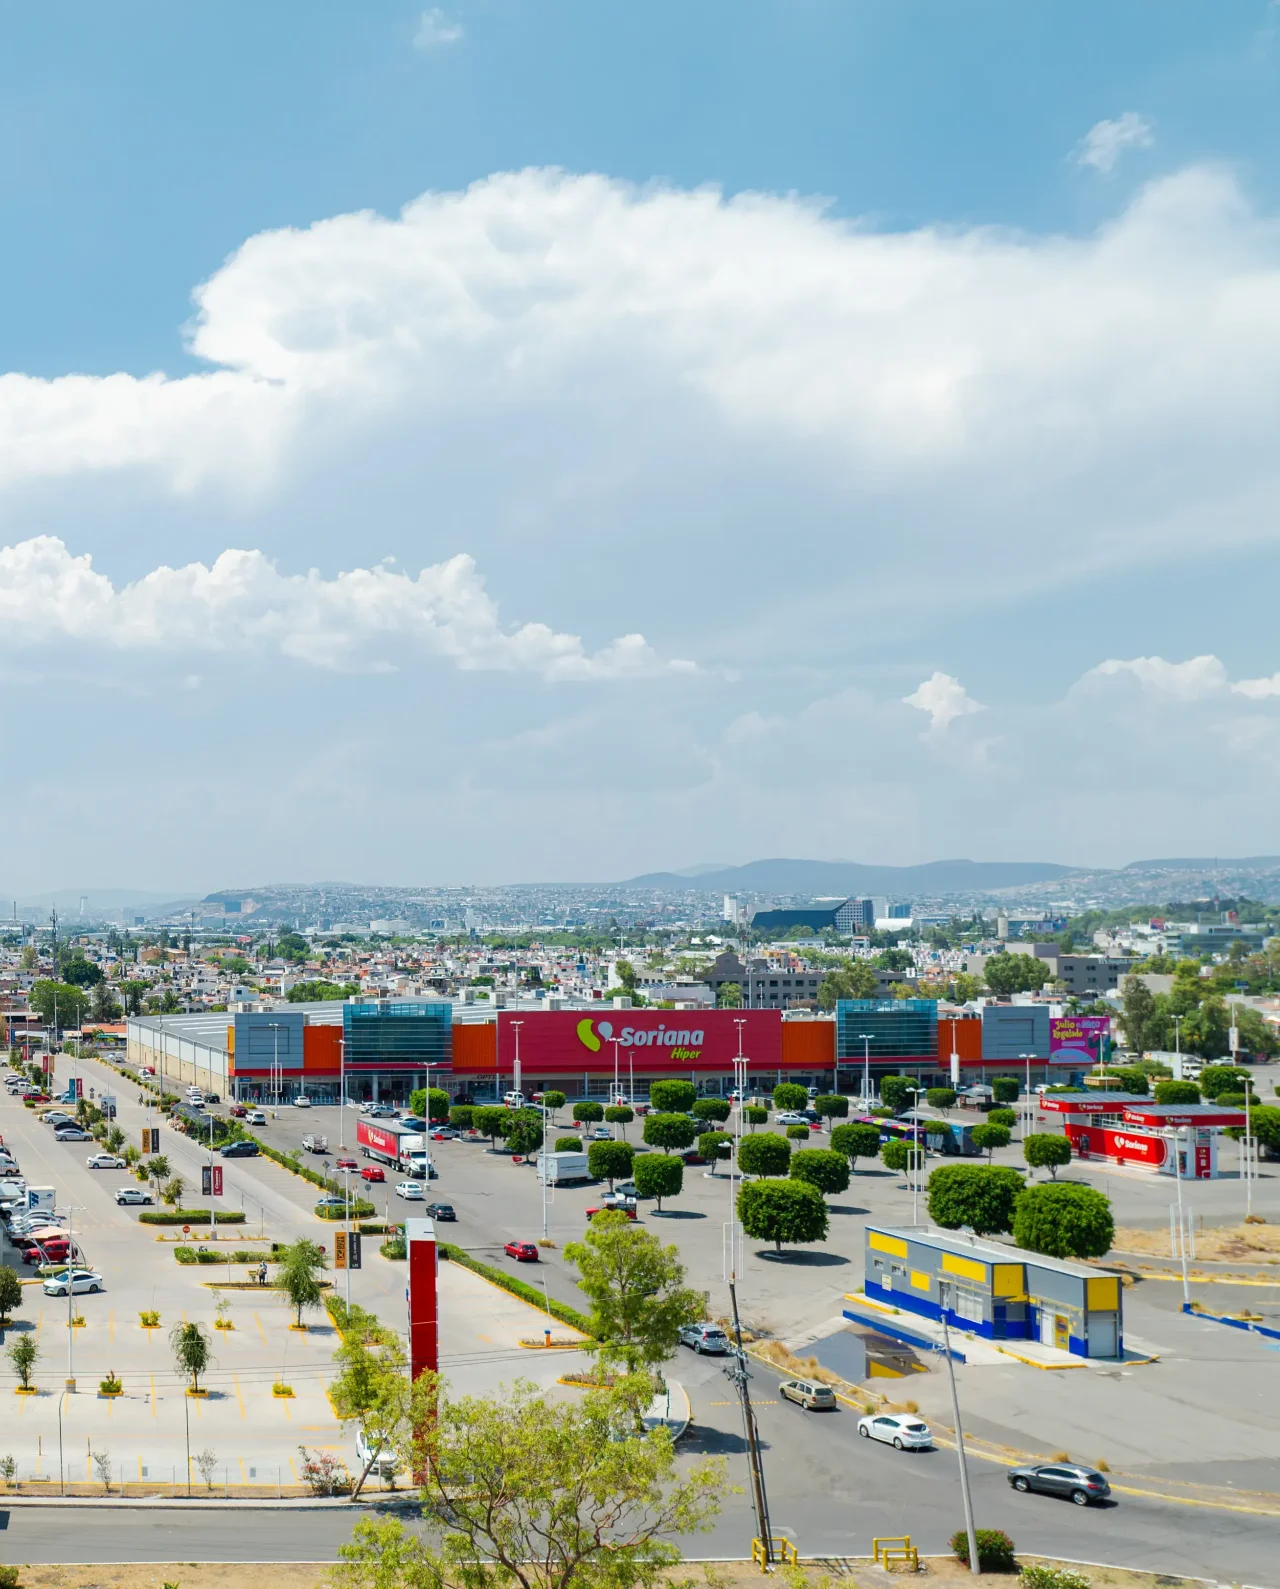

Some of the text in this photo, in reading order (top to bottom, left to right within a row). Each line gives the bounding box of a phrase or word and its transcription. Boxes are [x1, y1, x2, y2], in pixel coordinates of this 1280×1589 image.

[1055, 1019, 1075, 1030] Julio
[620, 1024, 704, 1047] Soriana
[1053, 1028, 1083, 1040] Regalado
[1124, 1139, 1148, 1152] Soriana
